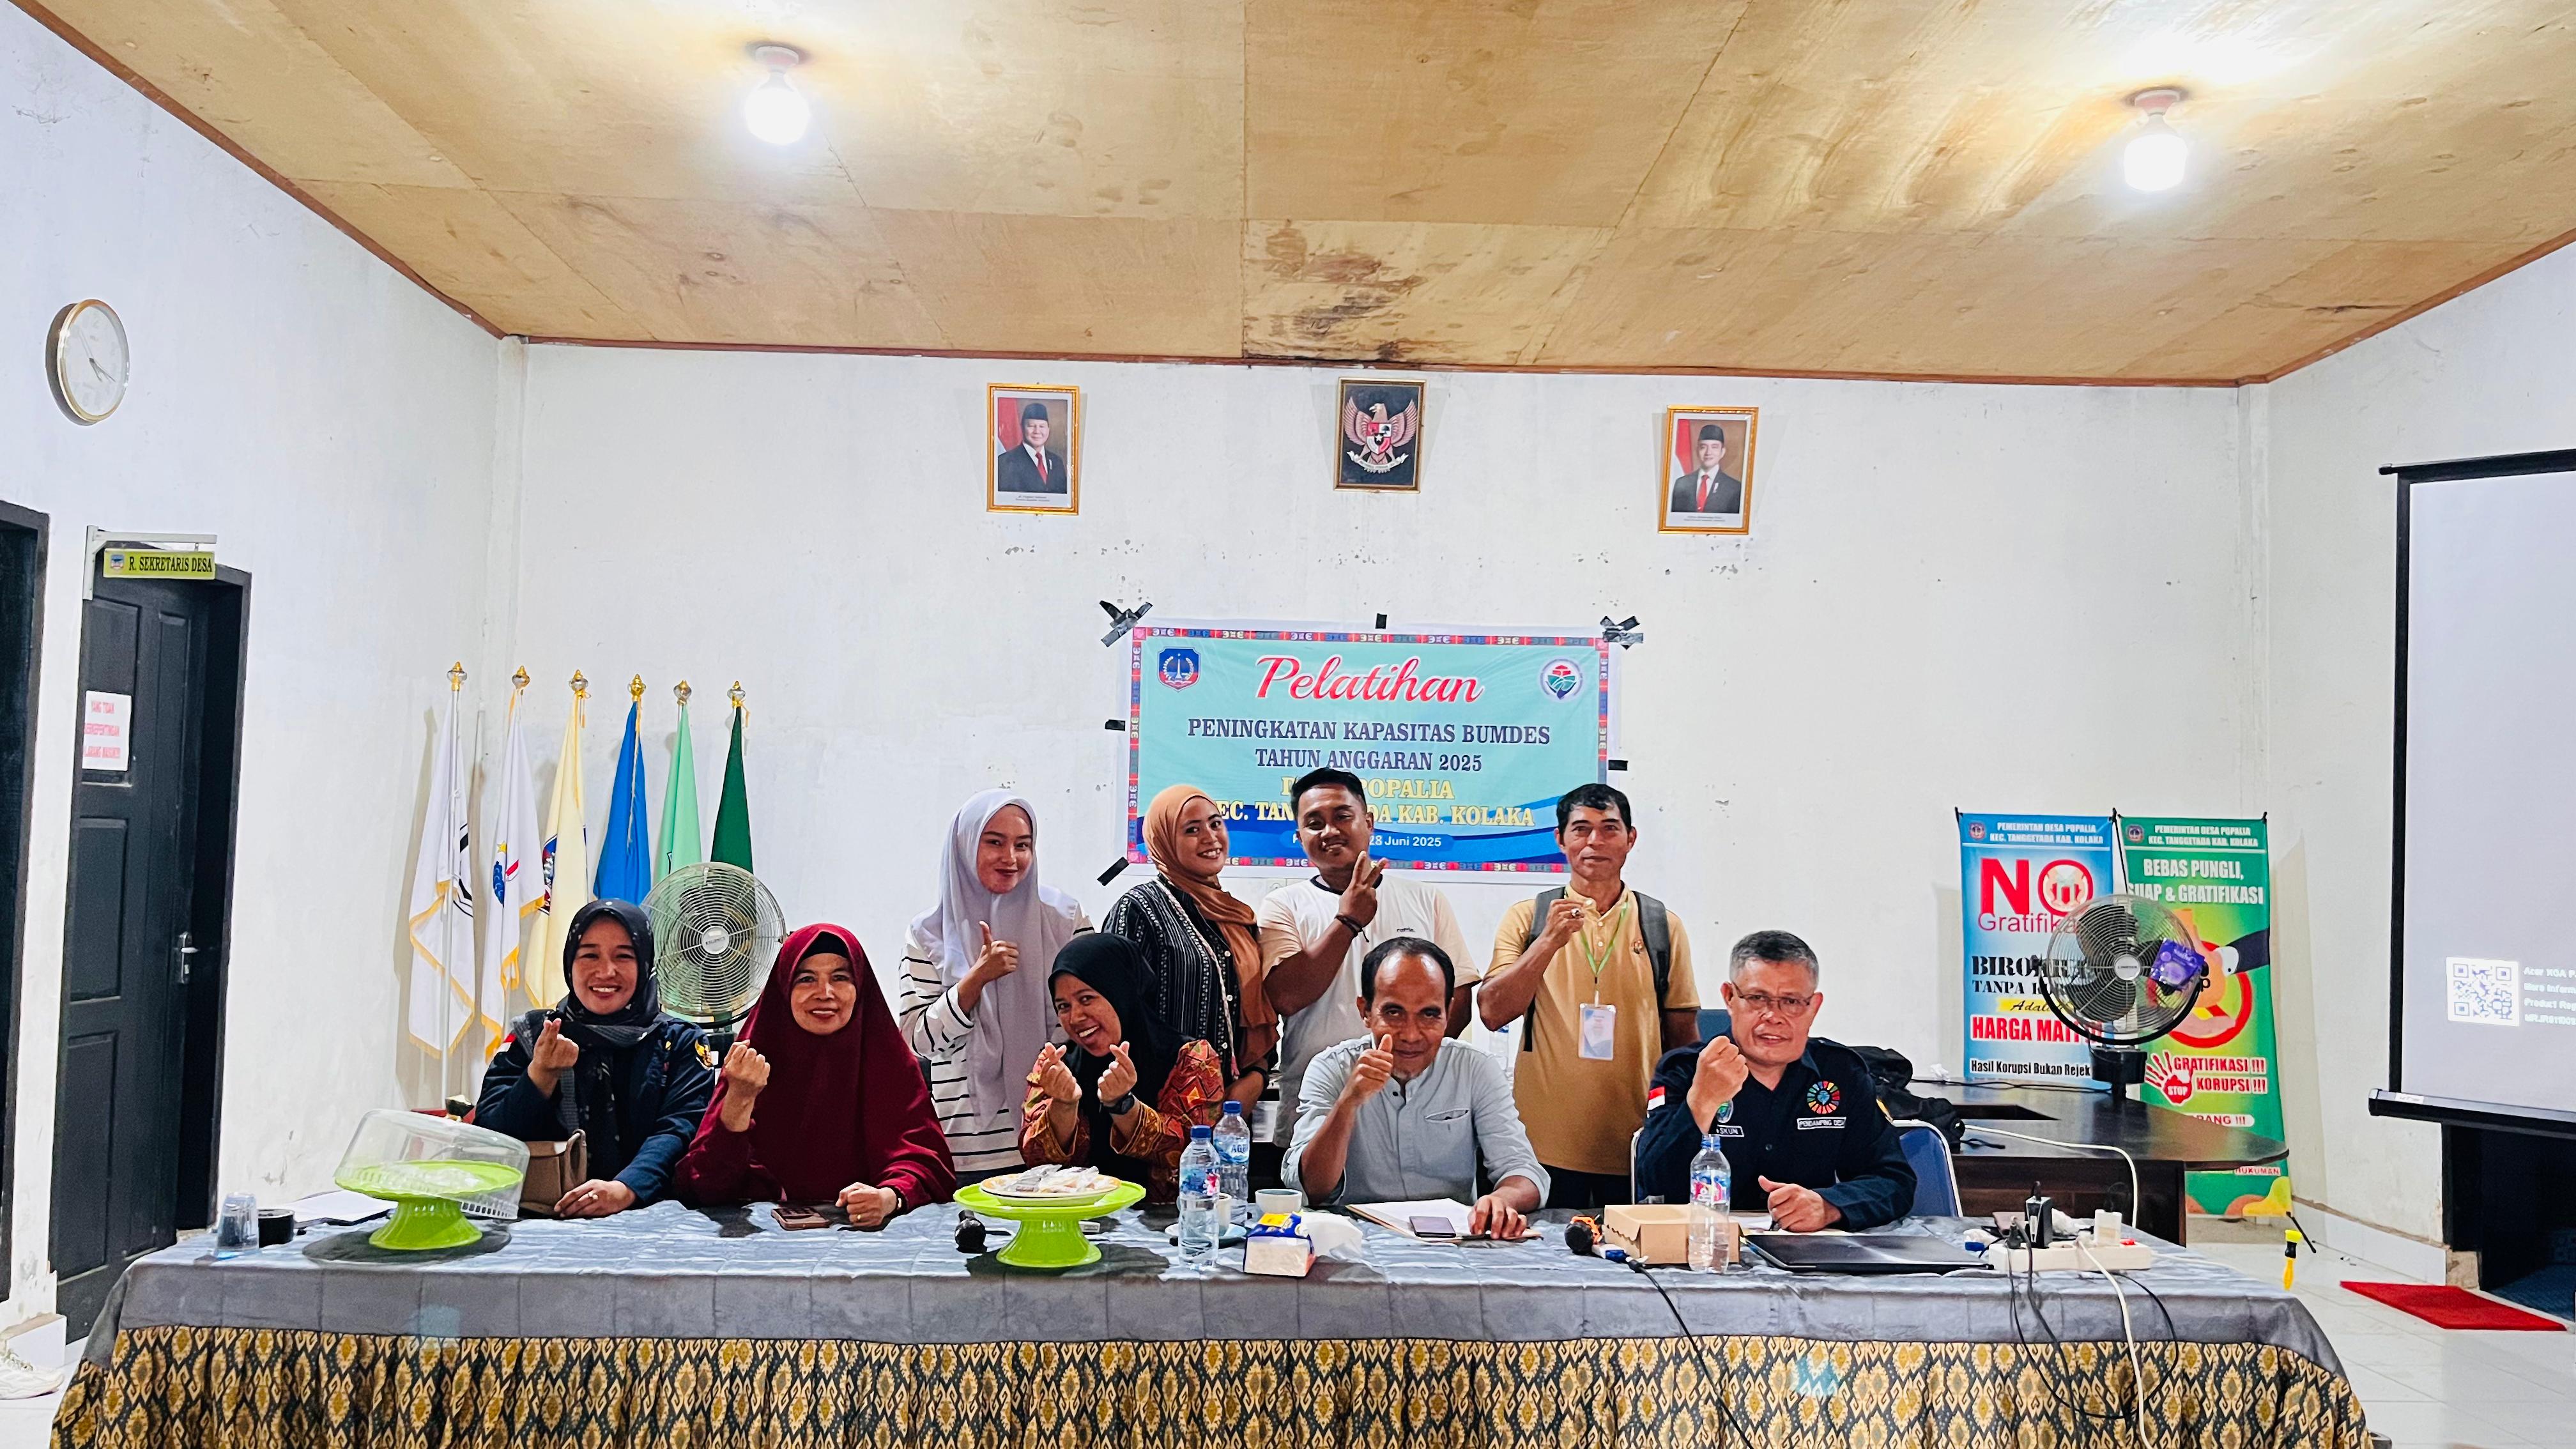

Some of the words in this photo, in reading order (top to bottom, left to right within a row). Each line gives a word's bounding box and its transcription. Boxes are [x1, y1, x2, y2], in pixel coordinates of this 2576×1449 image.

[128, 556, 137, 571] R.
[139, 556, 189, 572] SEKRETARIS
[191, 557, 212, 572] DESA
[1256, 656, 1485, 703] Pelatihan
[1188, 718, 1337, 740] PENINGKATAN
[1343, 721, 1455, 742] KAPASITAS
[1462, 724, 1550, 744] BUMDES
[1255, 748, 1321, 768] TAHUN
[1326, 750, 1433, 770] ANGGARAN
[1439, 754, 1482, 772] 2025
[1215, 801, 1248, 821] EC.
[1397, 804, 1445, 825] KAB.
[1450, 805, 1535, 827] KOLAKA
[1384, 835, 1410, 847] Juni
[1413, 836, 1442, 847] 2025
[2143, 859, 2188, 877] BEBAS
[2191, 860, 2244, 880] PUNGLI,
[2165, 887, 2176, 902] &
[2178, 885, 2264, 905] GRATIFIKASI
[1972, 979, 2025, 994] TANPA
[1972, 1016, 2032, 1041] HARGA
[1971, 1060, 1994, 1073] Hasil
[1997, 1061, 2032, 1075] Korupsi
[2034, 1063, 2062, 1075] Bukan
[2065, 1064, 2090, 1077] Rejek
[2174, 1057, 2248, 1072] GRATIFIKASI
[2252, 1059, 2265, 1073] !!!
[2167, 1086, 2188, 1096] STOP
[2196, 1077, 2250, 1092] KORUPSI
[2253, 1079, 2266, 1092] !!!
